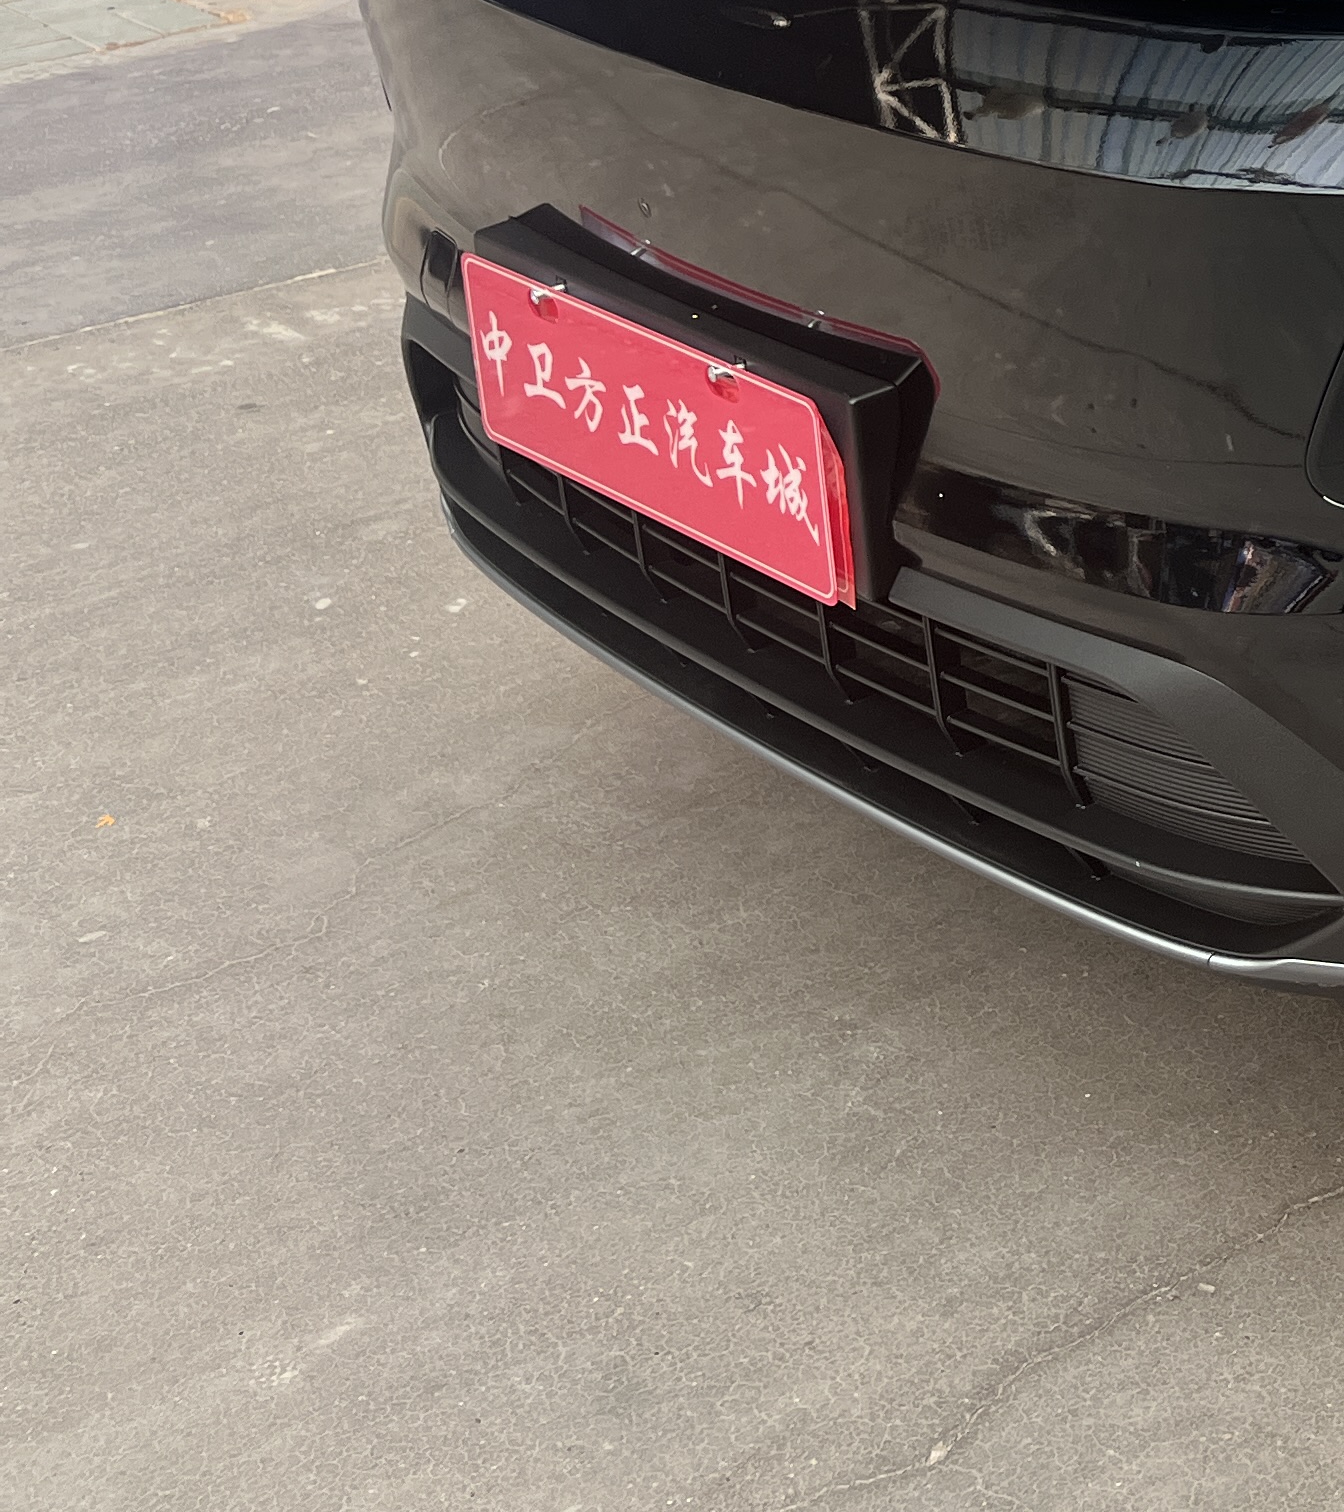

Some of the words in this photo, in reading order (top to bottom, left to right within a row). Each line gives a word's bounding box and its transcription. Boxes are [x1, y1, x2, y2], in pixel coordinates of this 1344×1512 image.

[480, 310, 821, 546] 中卫方正汽车城
